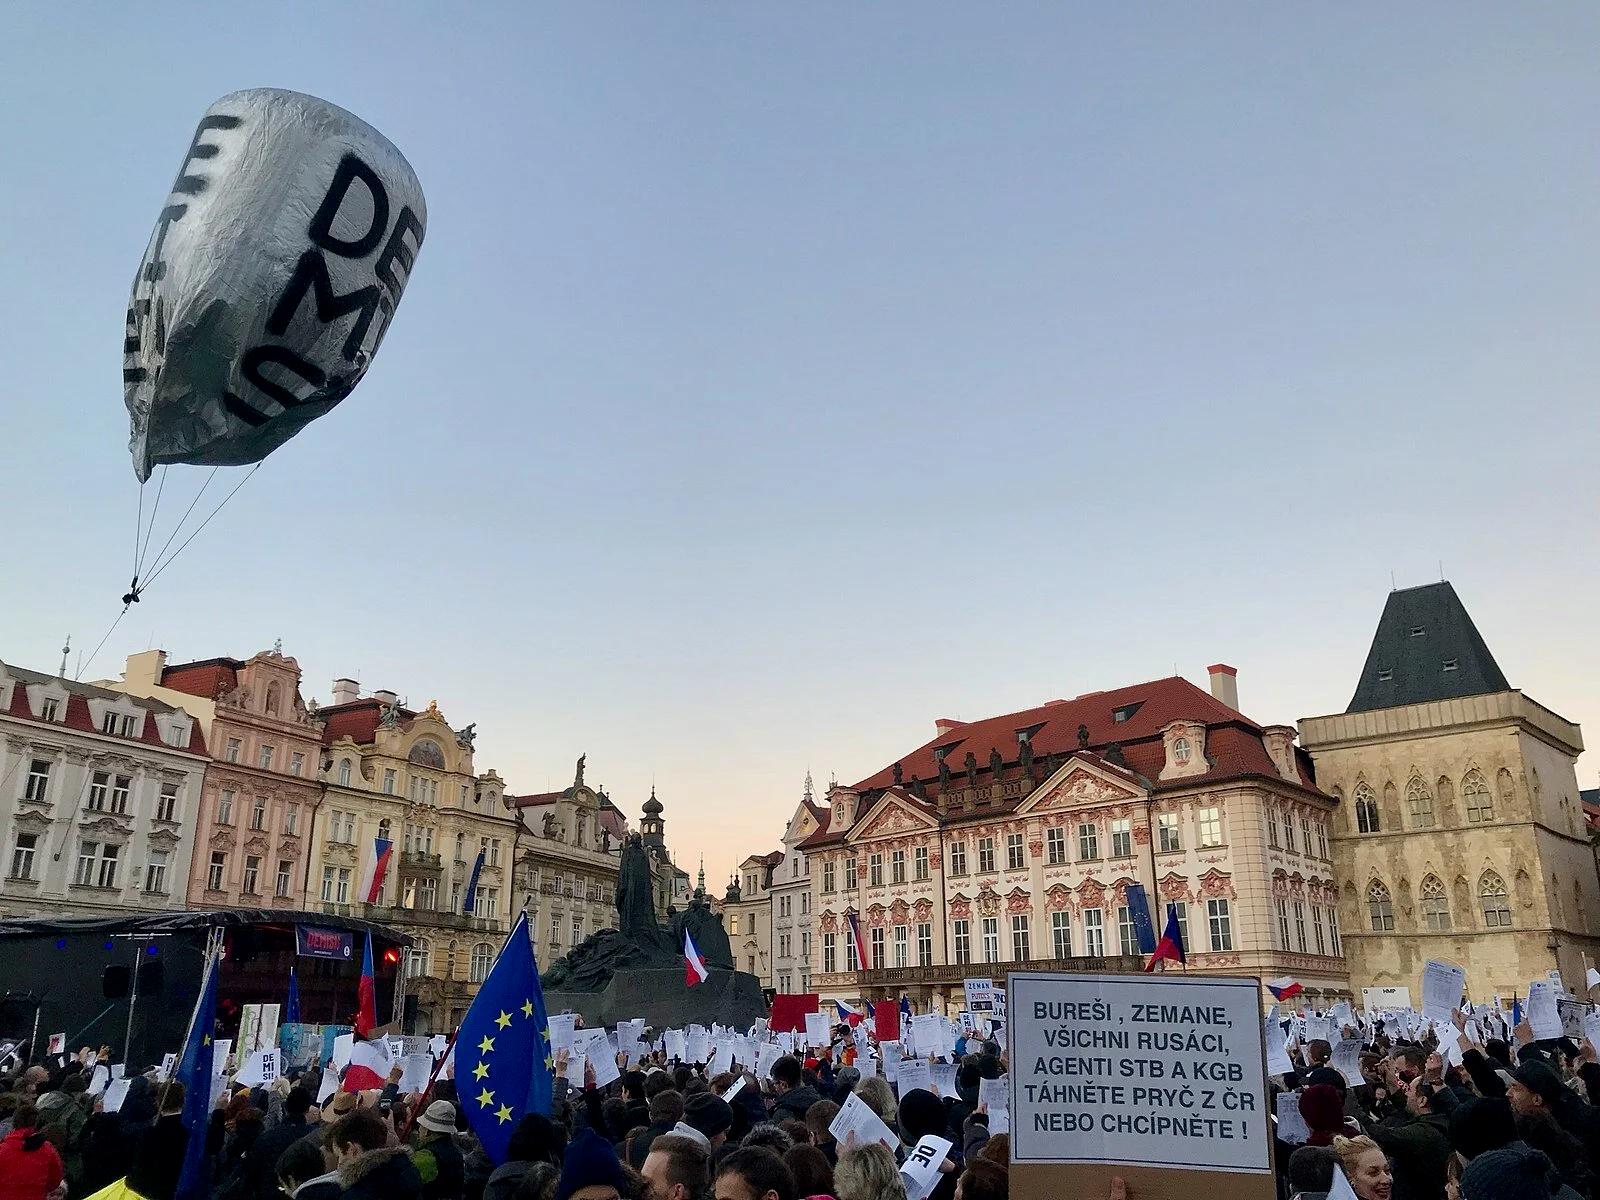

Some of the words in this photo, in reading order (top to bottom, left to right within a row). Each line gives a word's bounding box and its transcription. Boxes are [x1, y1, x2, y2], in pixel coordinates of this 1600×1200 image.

[968, 982, 990, 990] ZEMAN
[1034, 998, 1111, 1021] BUREŠI
[1132, 1004, 1232, 1028] ZEMANE,
[1044, 1025, 1128, 1048] VŠICHNI
[1138, 1029, 1229, 1056] RUSÁCI,
[262, 1053, 275, 1062] DE
[262, 1062, 275, 1073] MI
[1033, 1057, 1113, 1075] AGENTI
[1120, 1059, 1165, 1077] STB
[1172, 1061, 1188, 1079] A
[1194, 1062, 1243, 1081] KGB
[1025, 1080, 1125, 1104] TÁHNĚTE
[1133, 1085, 1195, 1108] PRYČ
[1201, 1091, 1216, 1109] Z
[1223, 1087, 1255, 1111] ČR
[1034, 1113, 1094, 1132] NEBO
[1101, 1111, 1233, 1139] CHCÍPNĚTE
[1242, 1121, 1248, 1140] !
